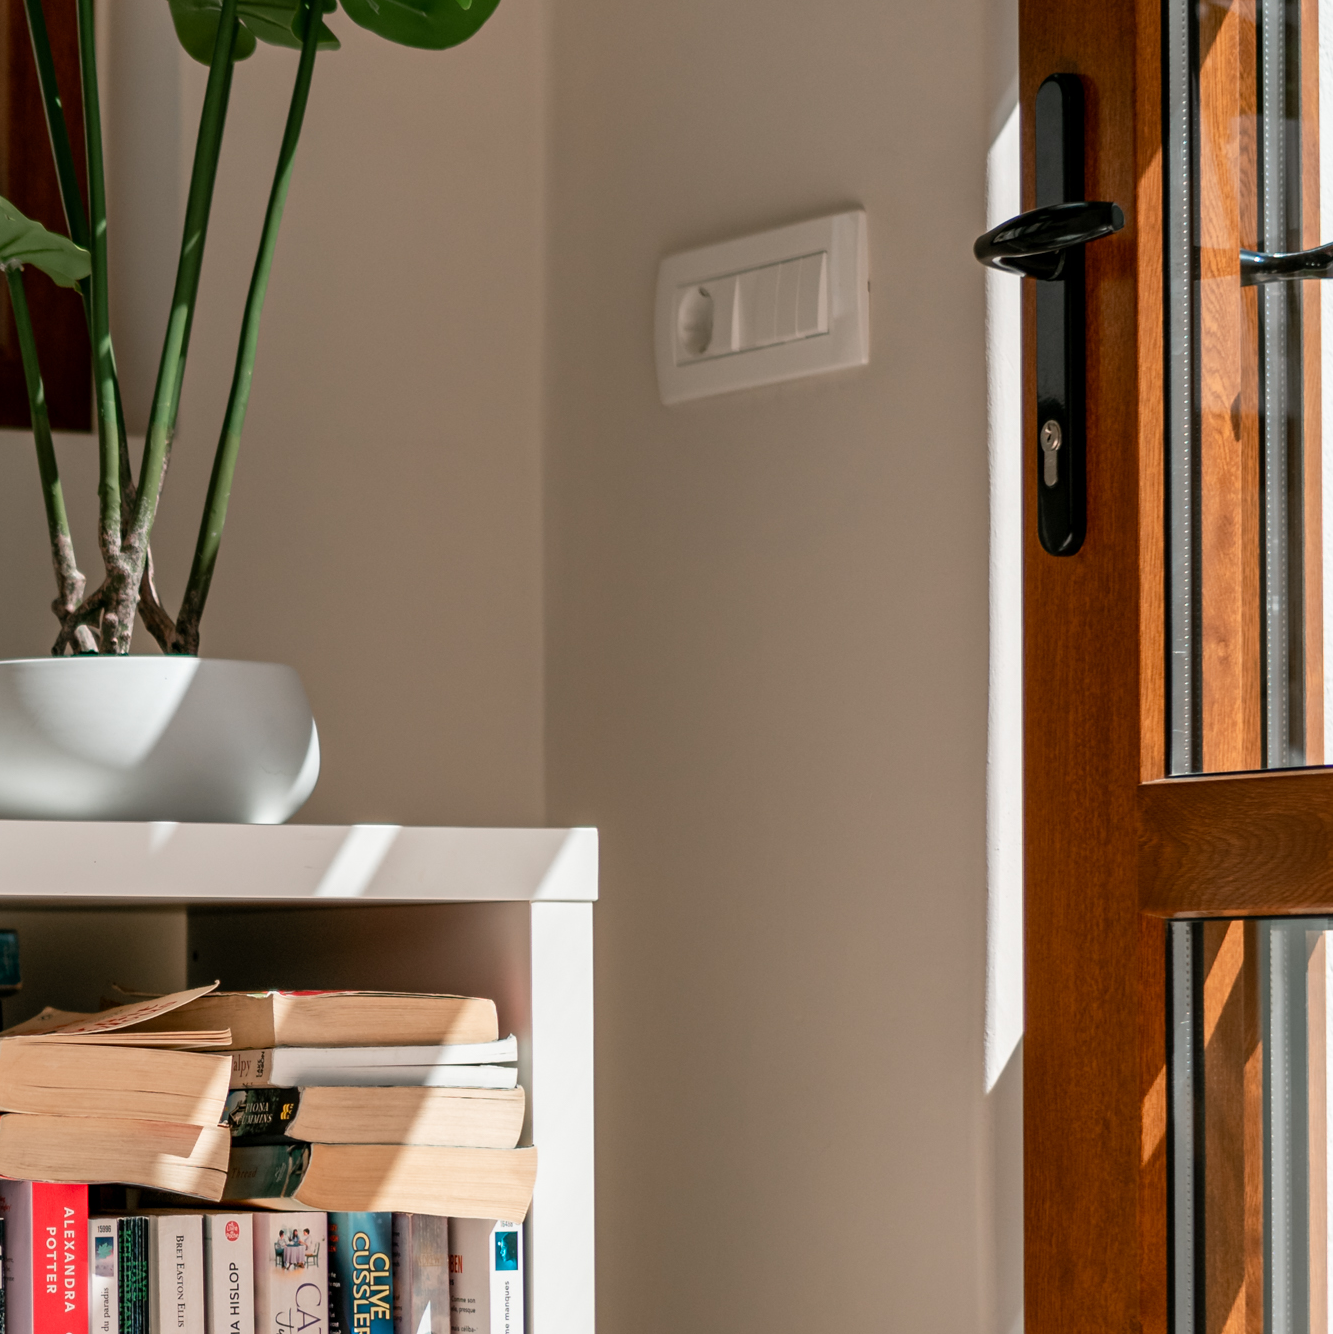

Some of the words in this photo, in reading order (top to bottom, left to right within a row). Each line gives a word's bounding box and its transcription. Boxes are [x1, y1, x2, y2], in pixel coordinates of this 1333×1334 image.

[46, 1226, 57, 1294] POTTER
[63, 1207, 76, 1313] ALEXANDRA
[229, 1262, 240, 1322] HISLOP
[369, 1252, 390, 1320] CLIVE
